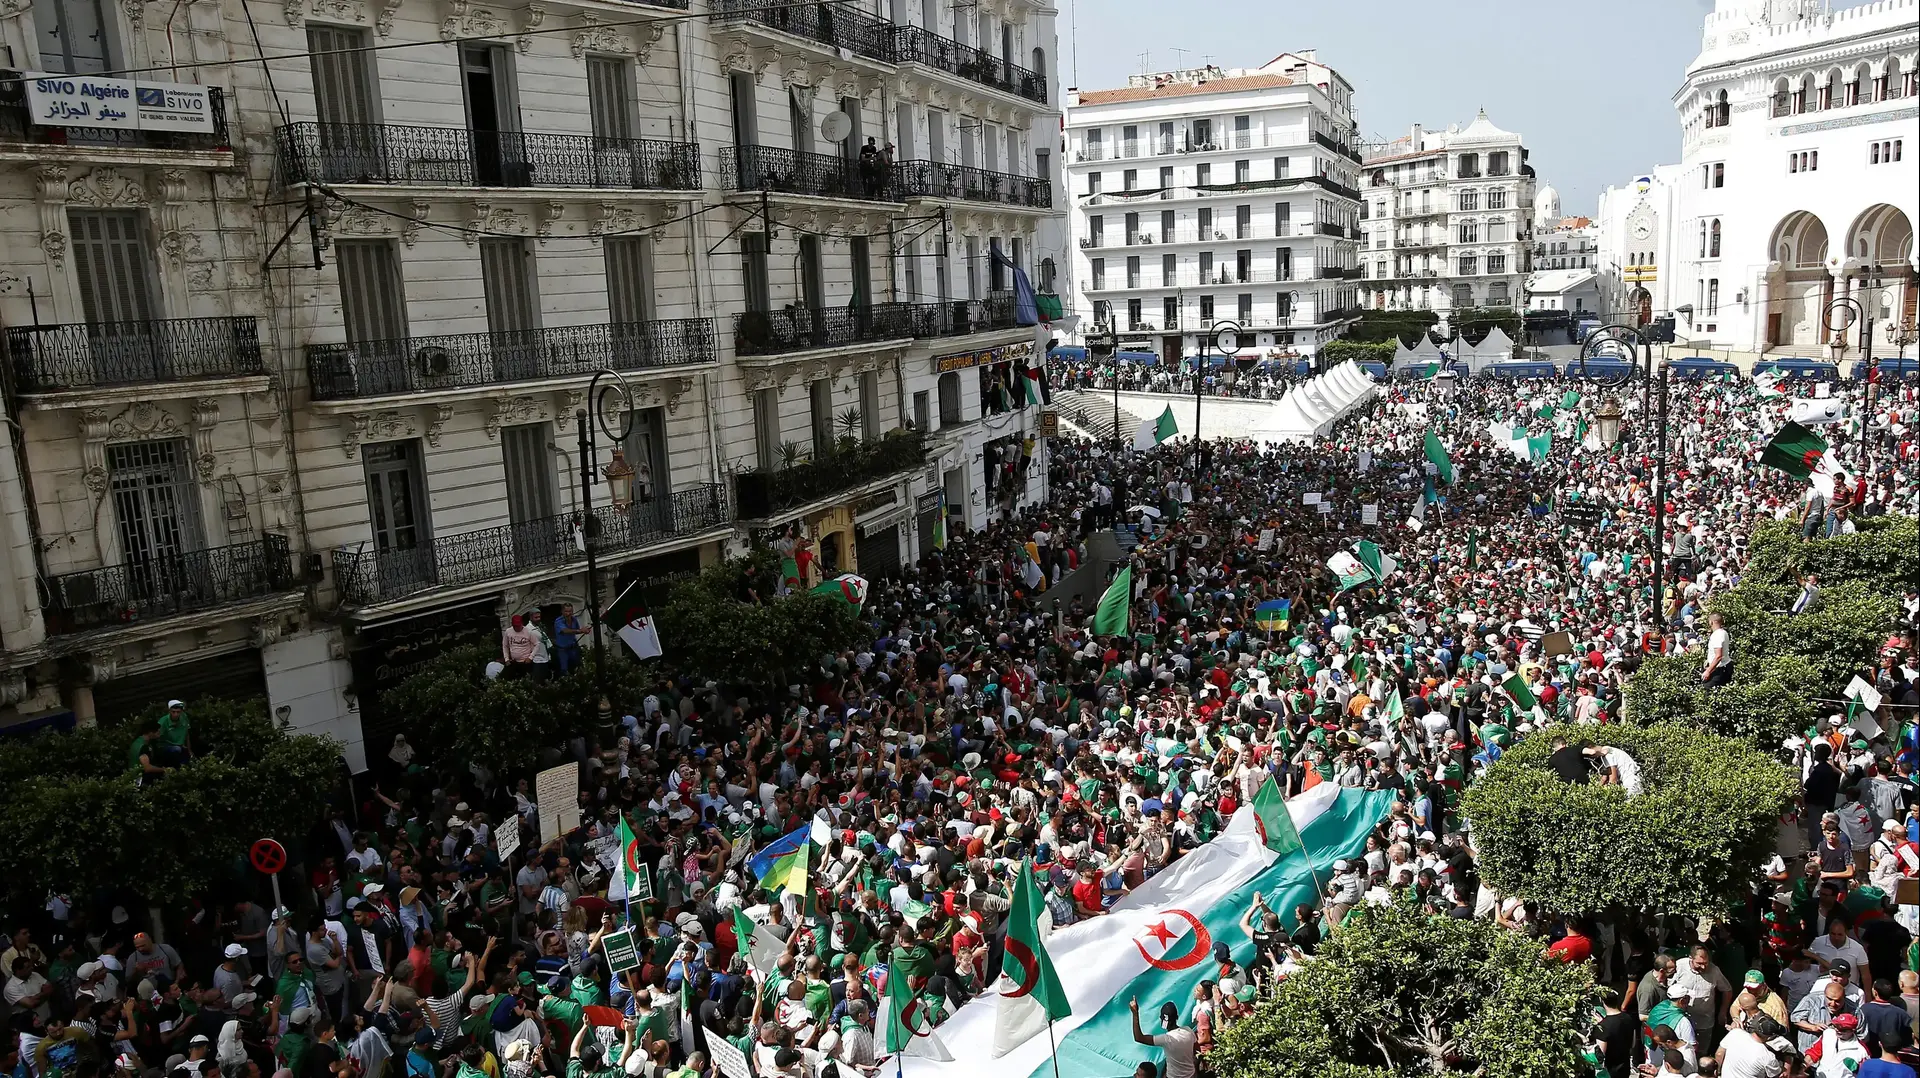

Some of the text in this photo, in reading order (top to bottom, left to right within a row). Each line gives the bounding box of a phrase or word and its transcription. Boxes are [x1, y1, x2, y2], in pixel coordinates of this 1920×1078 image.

[37, 79, 130, 100] SIVO Algérie
[167, 97, 203, 110] SIVO
